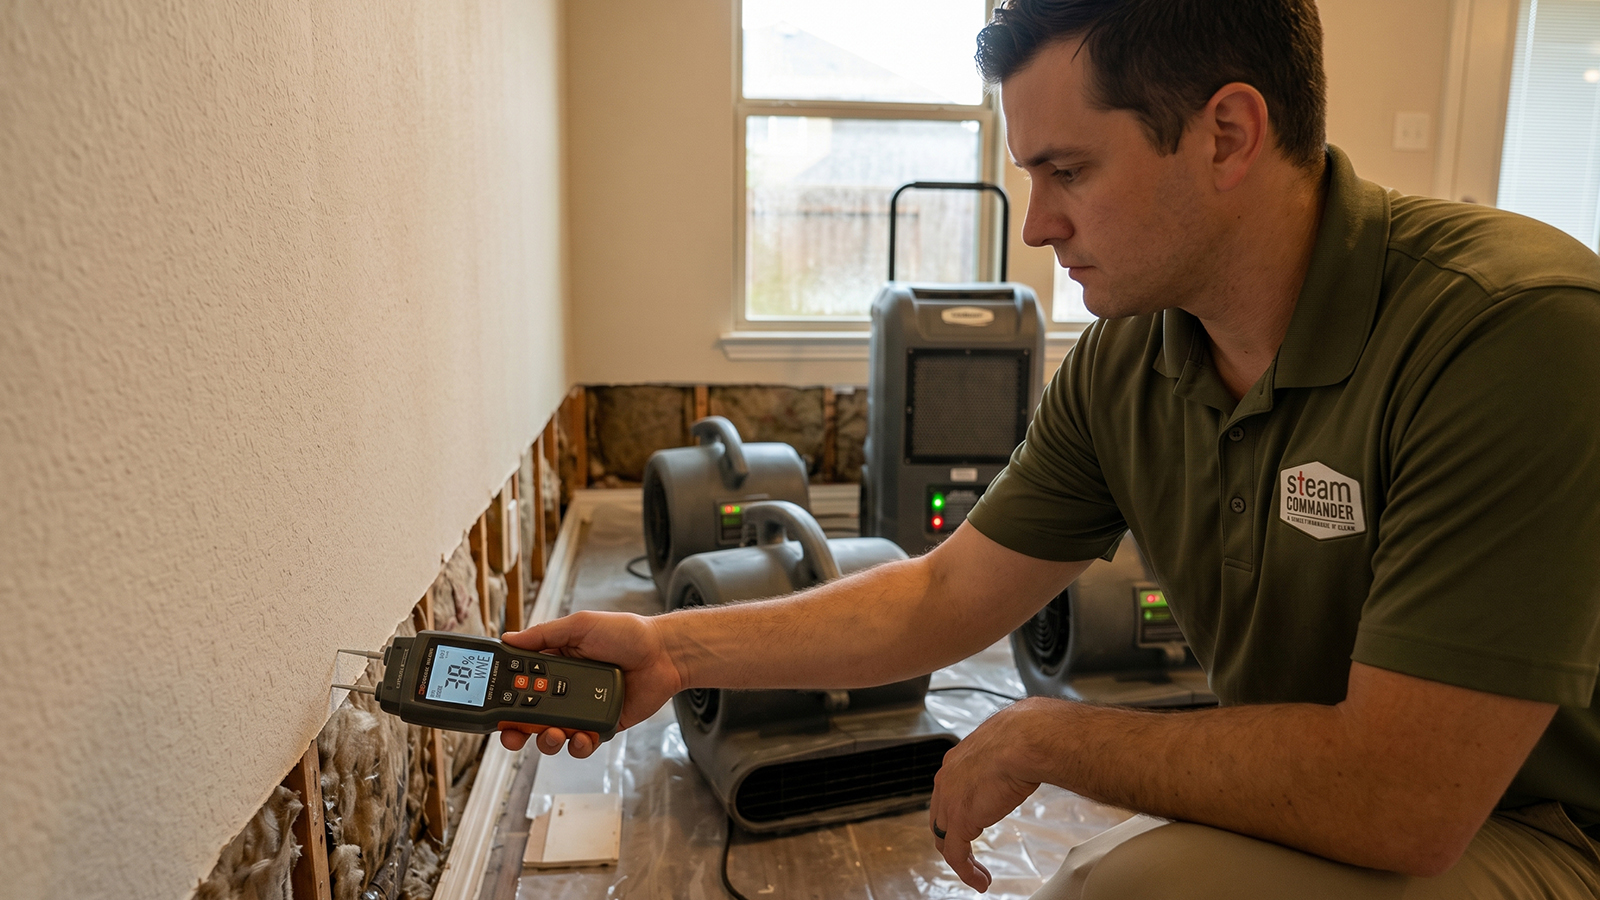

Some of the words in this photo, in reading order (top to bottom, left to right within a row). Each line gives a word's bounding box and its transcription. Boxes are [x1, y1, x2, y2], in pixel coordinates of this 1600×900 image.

[1287, 471, 1351, 503] steam
[1287, 496, 1354, 521] COMMANDER
[474, 655, 490, 679] WNE
